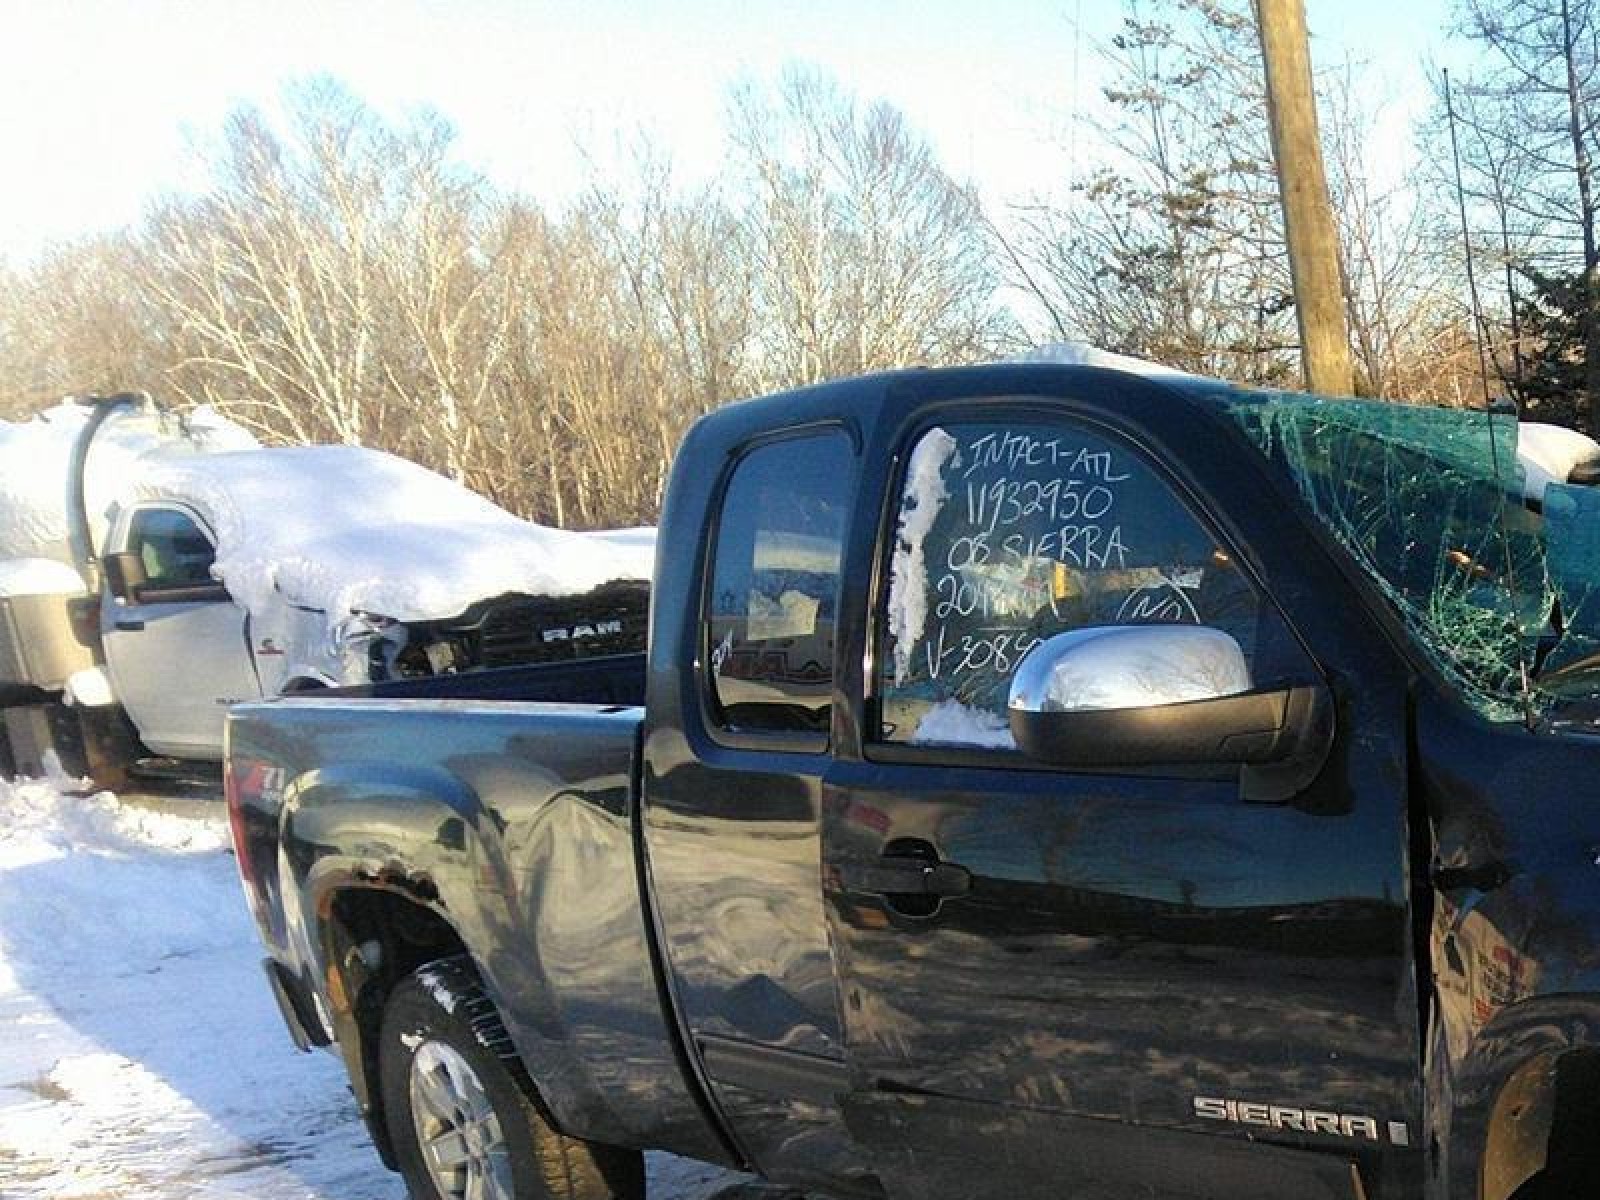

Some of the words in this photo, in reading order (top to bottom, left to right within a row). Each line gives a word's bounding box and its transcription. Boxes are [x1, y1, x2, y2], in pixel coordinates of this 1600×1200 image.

[967, 477, 1113, 534] 11932950
[1001, 524, 1130, 570] SIERRA
[543, 621, 621, 642] RAM
[1194, 1097, 1377, 1141] SIERRA
